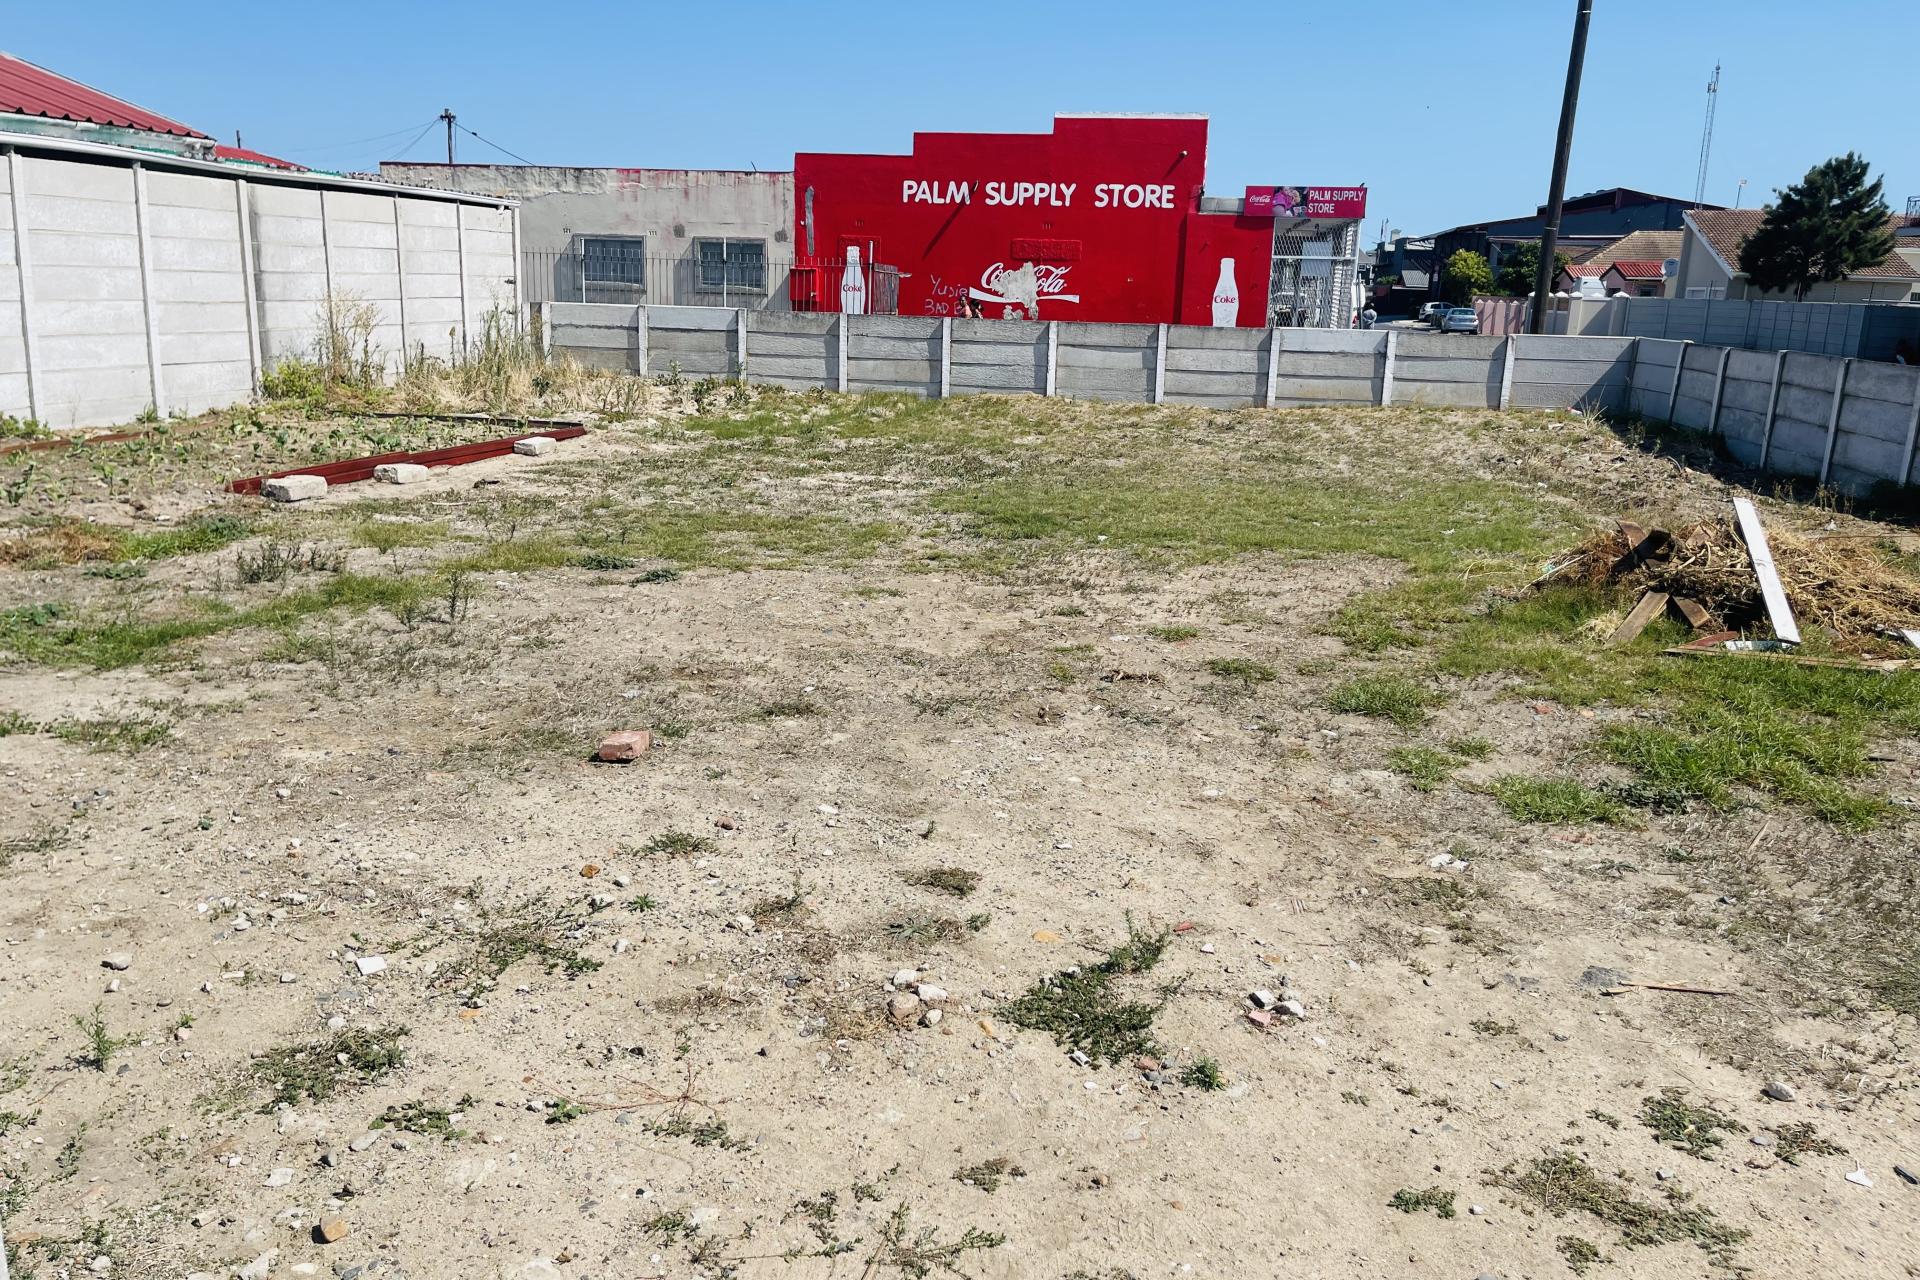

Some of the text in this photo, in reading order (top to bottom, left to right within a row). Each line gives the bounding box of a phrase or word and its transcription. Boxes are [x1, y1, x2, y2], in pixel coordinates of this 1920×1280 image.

[903, 180, 1176, 209] PALM SUPPLY STORE
[1309, 190, 1364, 202] PALM SUPPLY
[1308, 203, 1335, 214] STORE
[1213, 294, 1236, 304] Coke
